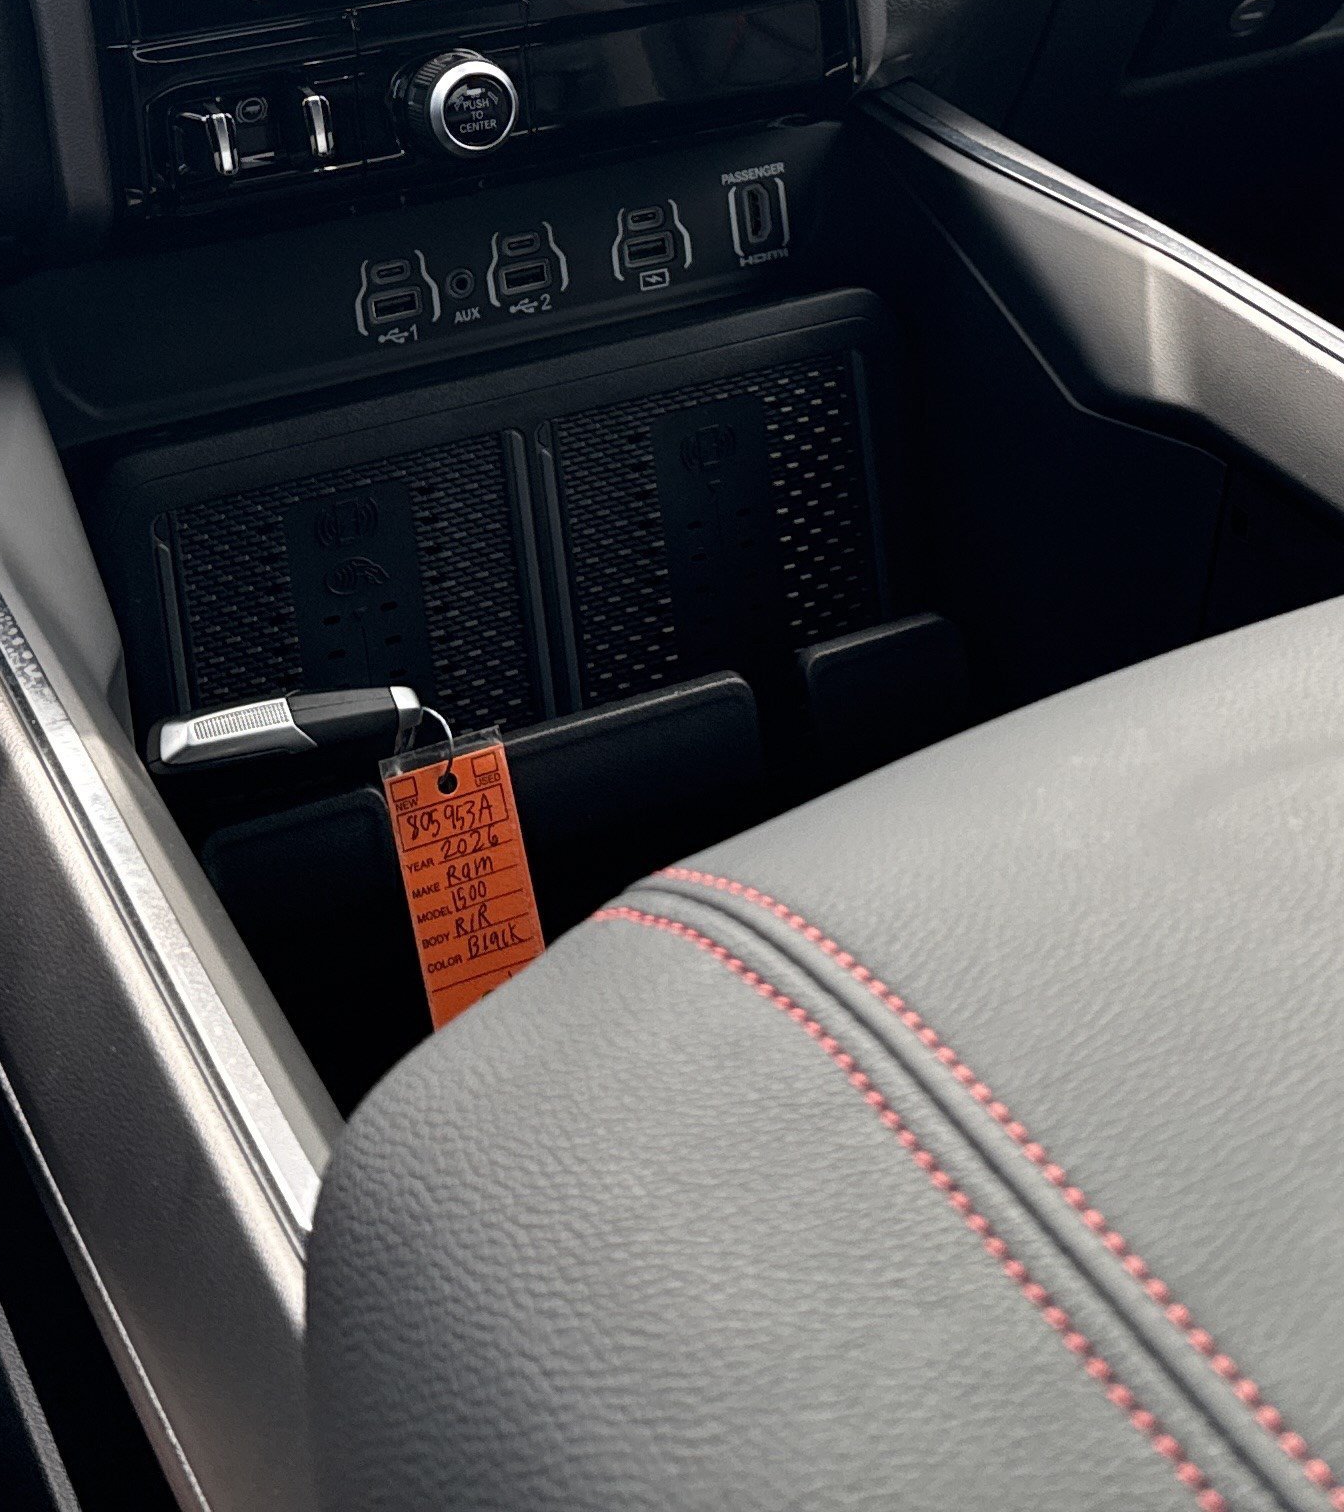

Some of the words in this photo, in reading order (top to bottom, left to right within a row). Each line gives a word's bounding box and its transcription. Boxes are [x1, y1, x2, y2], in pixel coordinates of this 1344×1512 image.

[462, 99, 489, 112] PUSH
[471, 110, 484, 120] TO
[460, 119, 497, 133] CENTER
[721, 162, 785, 186] PASSENGER
[540, 294, 552, 311] 2
[454, 306, 481, 324] AUX
[410, 324, 418, 340] 1
[475, 773, 501, 787] USED
[395, 798, 419, 812] NEW
[407, 857, 435, 873] YEAR
[412, 882, 440, 899] MAKE
[452, 880, 487, 912] 1500
[417, 906, 453, 924] MODEL
[423, 934, 450, 949] BODY
[427, 954, 462, 973] COLOR
